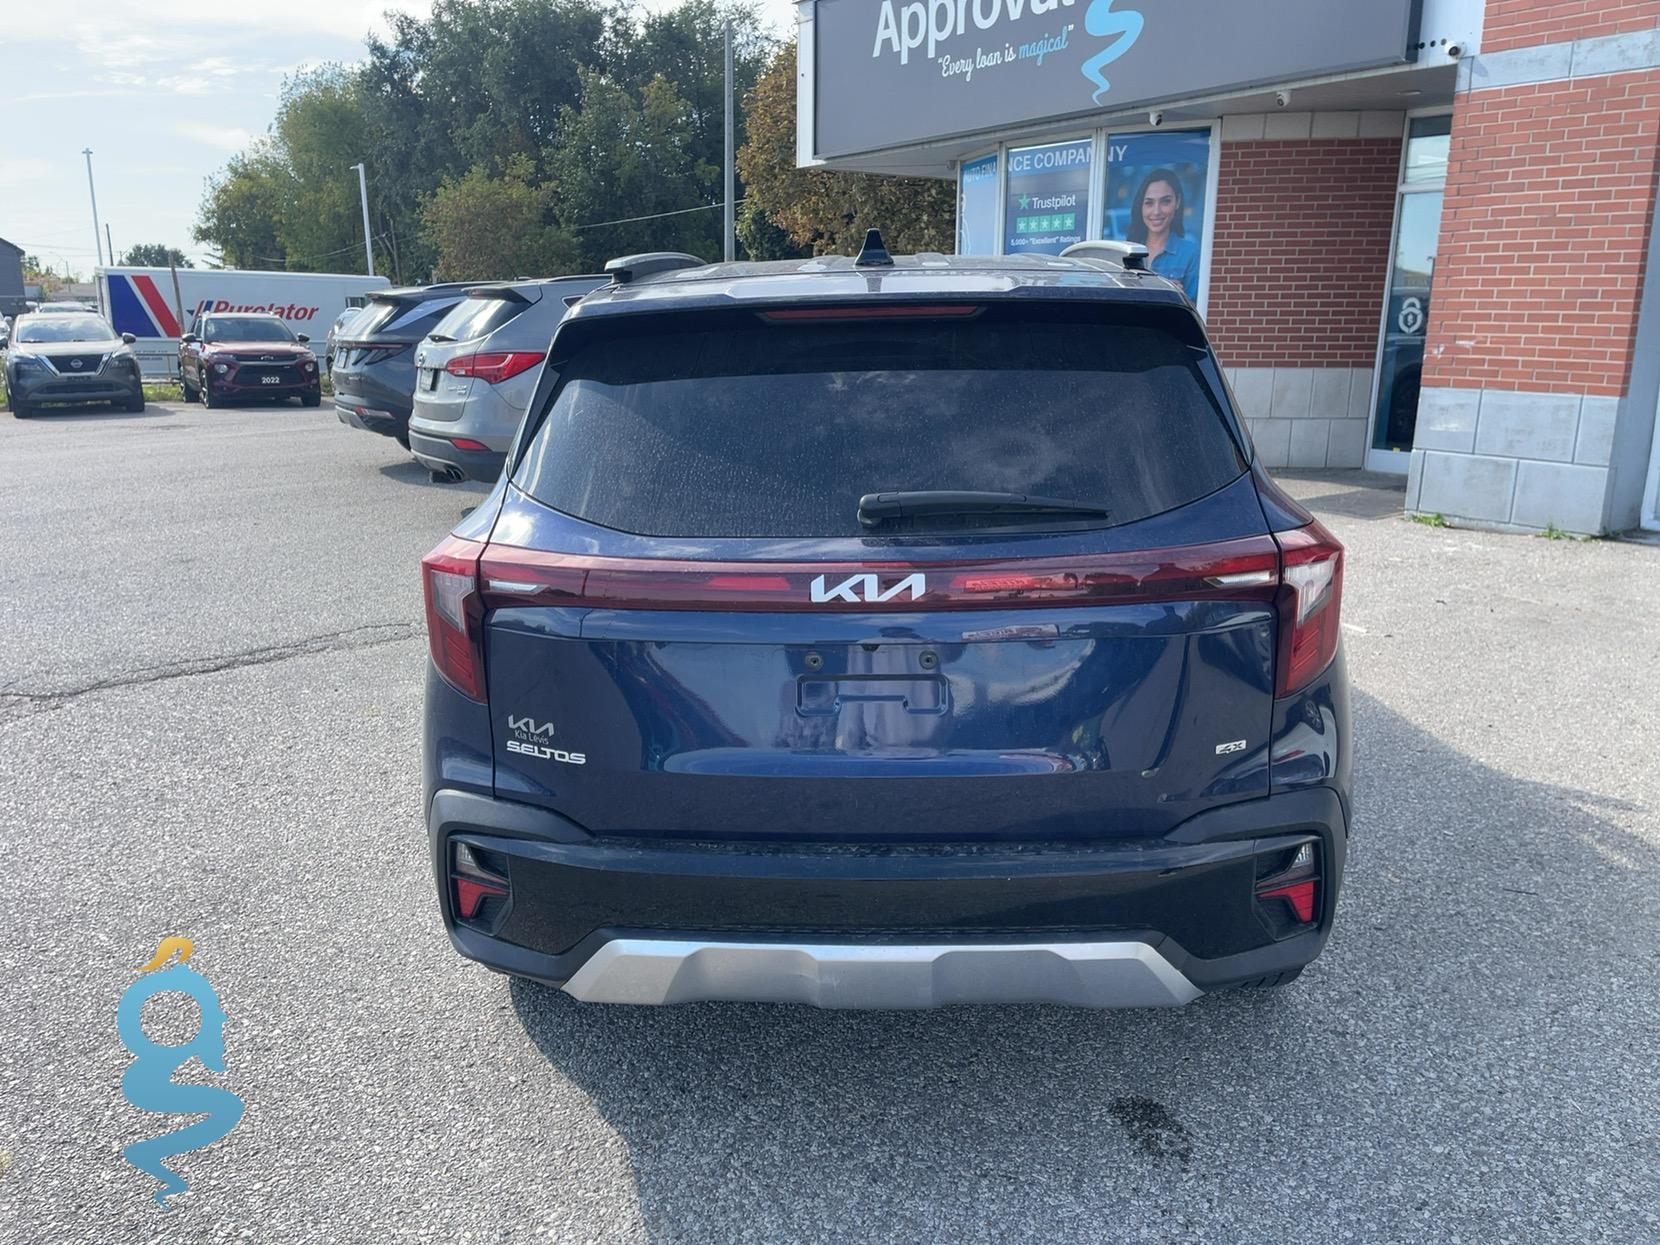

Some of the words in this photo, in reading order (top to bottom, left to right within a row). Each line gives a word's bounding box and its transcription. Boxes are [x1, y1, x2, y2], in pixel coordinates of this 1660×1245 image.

[872, 0, 1075, 65] Appro
[937, 55, 974, 82] "Every
[976, 48, 1003, 69] loan
[1004, 43, 1017, 61] is
[1019, 24, 1075, 66] magical"
[1034, 145, 1128, 169] COMPANY
[1032, 194, 1076, 210] Trustpilot
[261, 376, 280, 384] 2022
[811, 573, 925, 603] KIA
[508, 714, 555, 737] KIA
[514, 729, 527, 740] Kia
[506, 740, 586, 765] SELTOS
